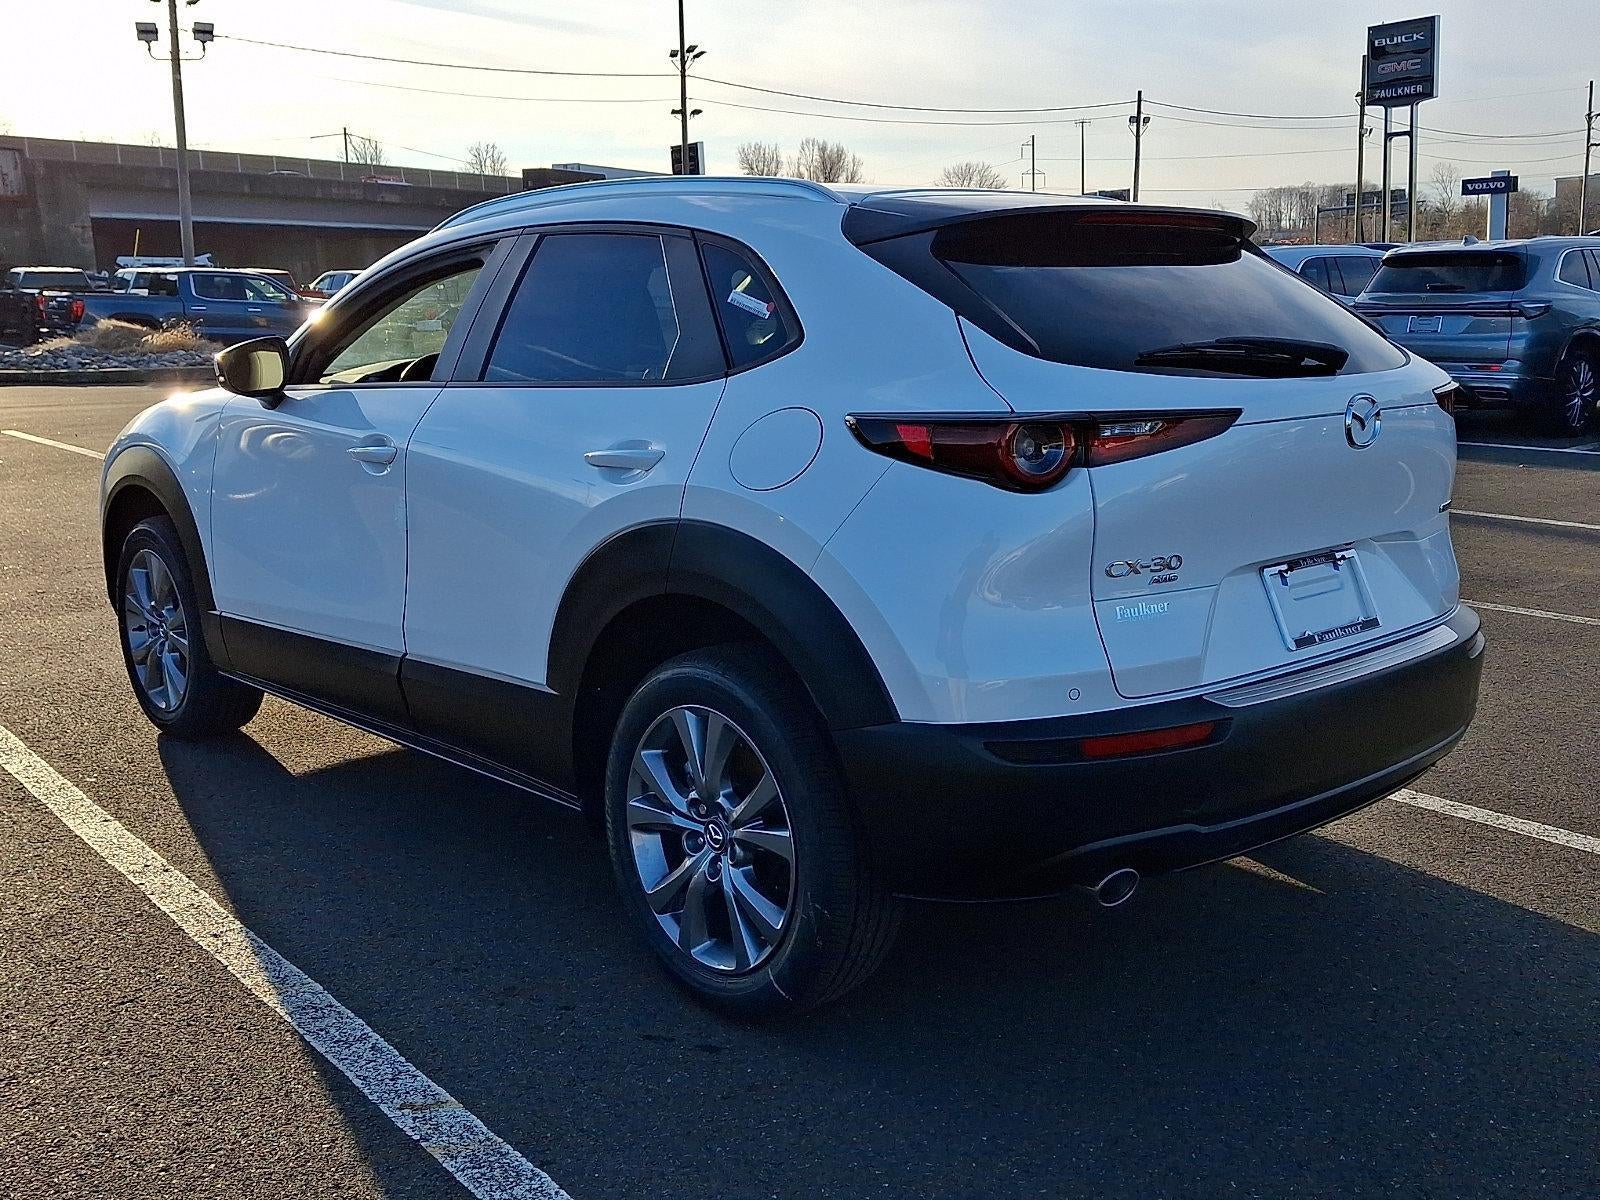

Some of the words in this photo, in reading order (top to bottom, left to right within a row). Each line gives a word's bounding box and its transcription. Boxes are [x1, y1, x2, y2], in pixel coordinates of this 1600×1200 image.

[1374, 31, 1425, 47] BUICK
[1377, 58, 1422, 75] GMC
[1374, 84, 1423, 99] FAULKNER
[1466, 181, 1506, 191] VOLVO
[1104, 554, 1184, 579] CX-30
[1148, 573, 1179, 586] AWD
[1115, 601, 1170, 619] Faulkner
[1314, 623, 1363, 644] Faulkner
